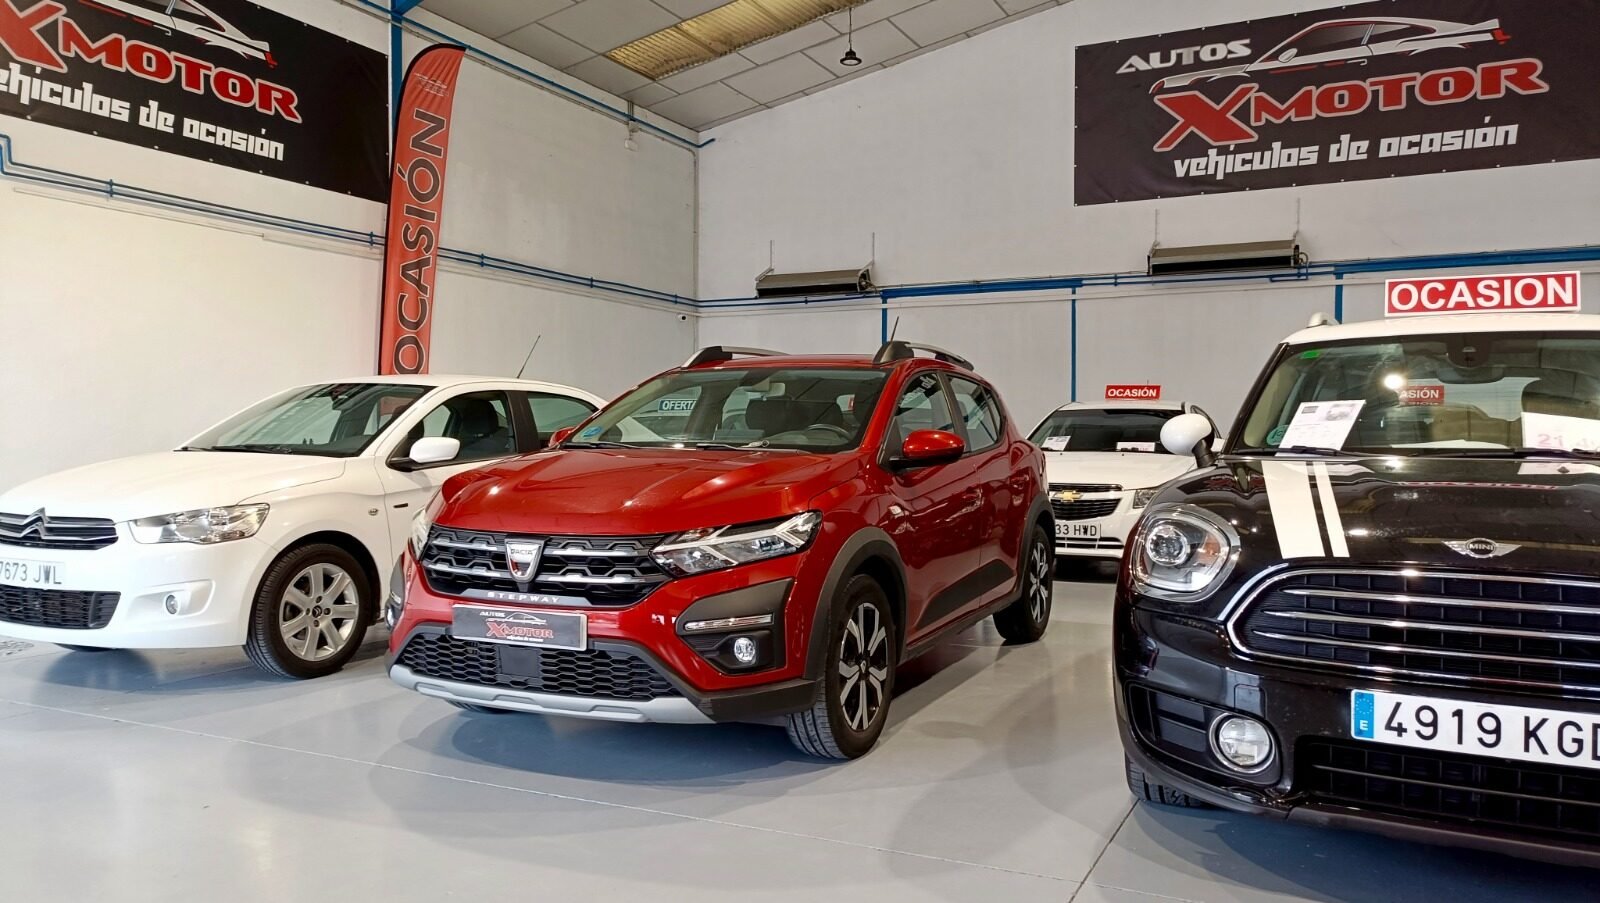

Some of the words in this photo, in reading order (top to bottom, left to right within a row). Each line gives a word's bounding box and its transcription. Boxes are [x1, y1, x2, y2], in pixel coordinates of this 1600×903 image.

[1116, 38, 1252, 75] AUTOS
[1153, 57, 1550, 152] XMOTOR
[138, 99, 175, 134] de
[182, 117, 285, 161] ocasión
[1174, 141, 1320, 180] vehículos
[1328, 133, 1370, 163] de
[1378, 115, 1519, 158] ocasión
[393, 107, 447, 375] OCASIÓN
[1390, 276, 1574, 311] OCASION
[1107, 386, 1157, 397] OCASIÓN
[1073, 524, 1097, 536] HWD
[1469, 543, 1494, 551] MINI
[33, 564, 62, 585] JWL
[487, 591, 561, 603] STEPWAY
[486, 621, 554, 639] XMOTOR
[1359, 719, 1369, 731] E
[1384, 701, 1502, 748] 4919
